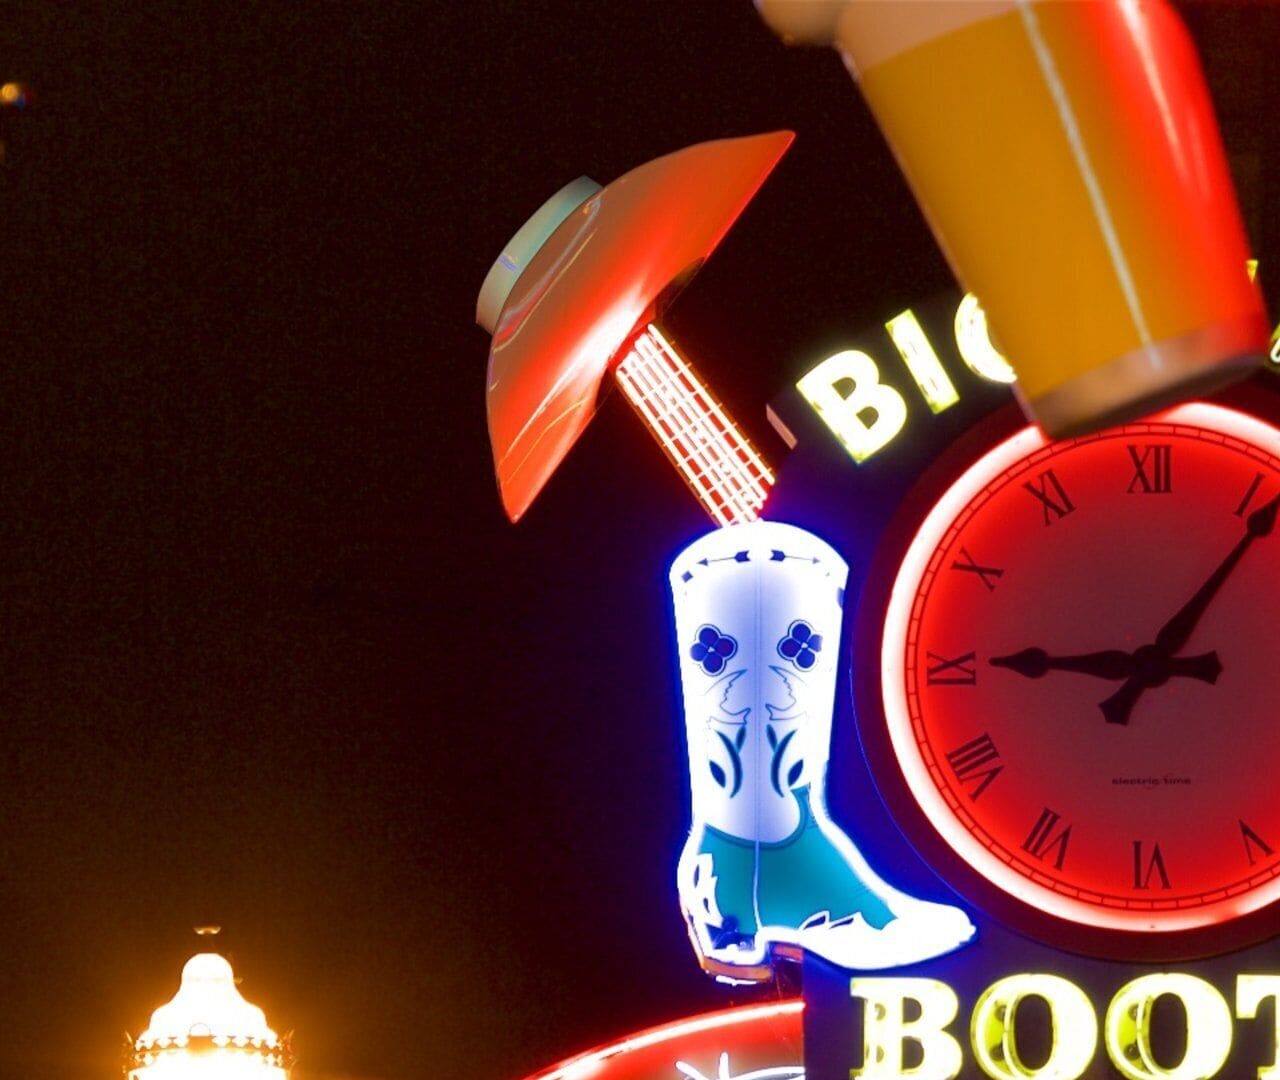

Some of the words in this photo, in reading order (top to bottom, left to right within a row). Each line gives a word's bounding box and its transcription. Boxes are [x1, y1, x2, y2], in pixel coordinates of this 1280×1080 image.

[1126, 445, 1172, 494] XII
[1024, 469, 1077, 526] XI
[950, 547, 1005, 592] X
[1238, 818, 1276, 866] V
